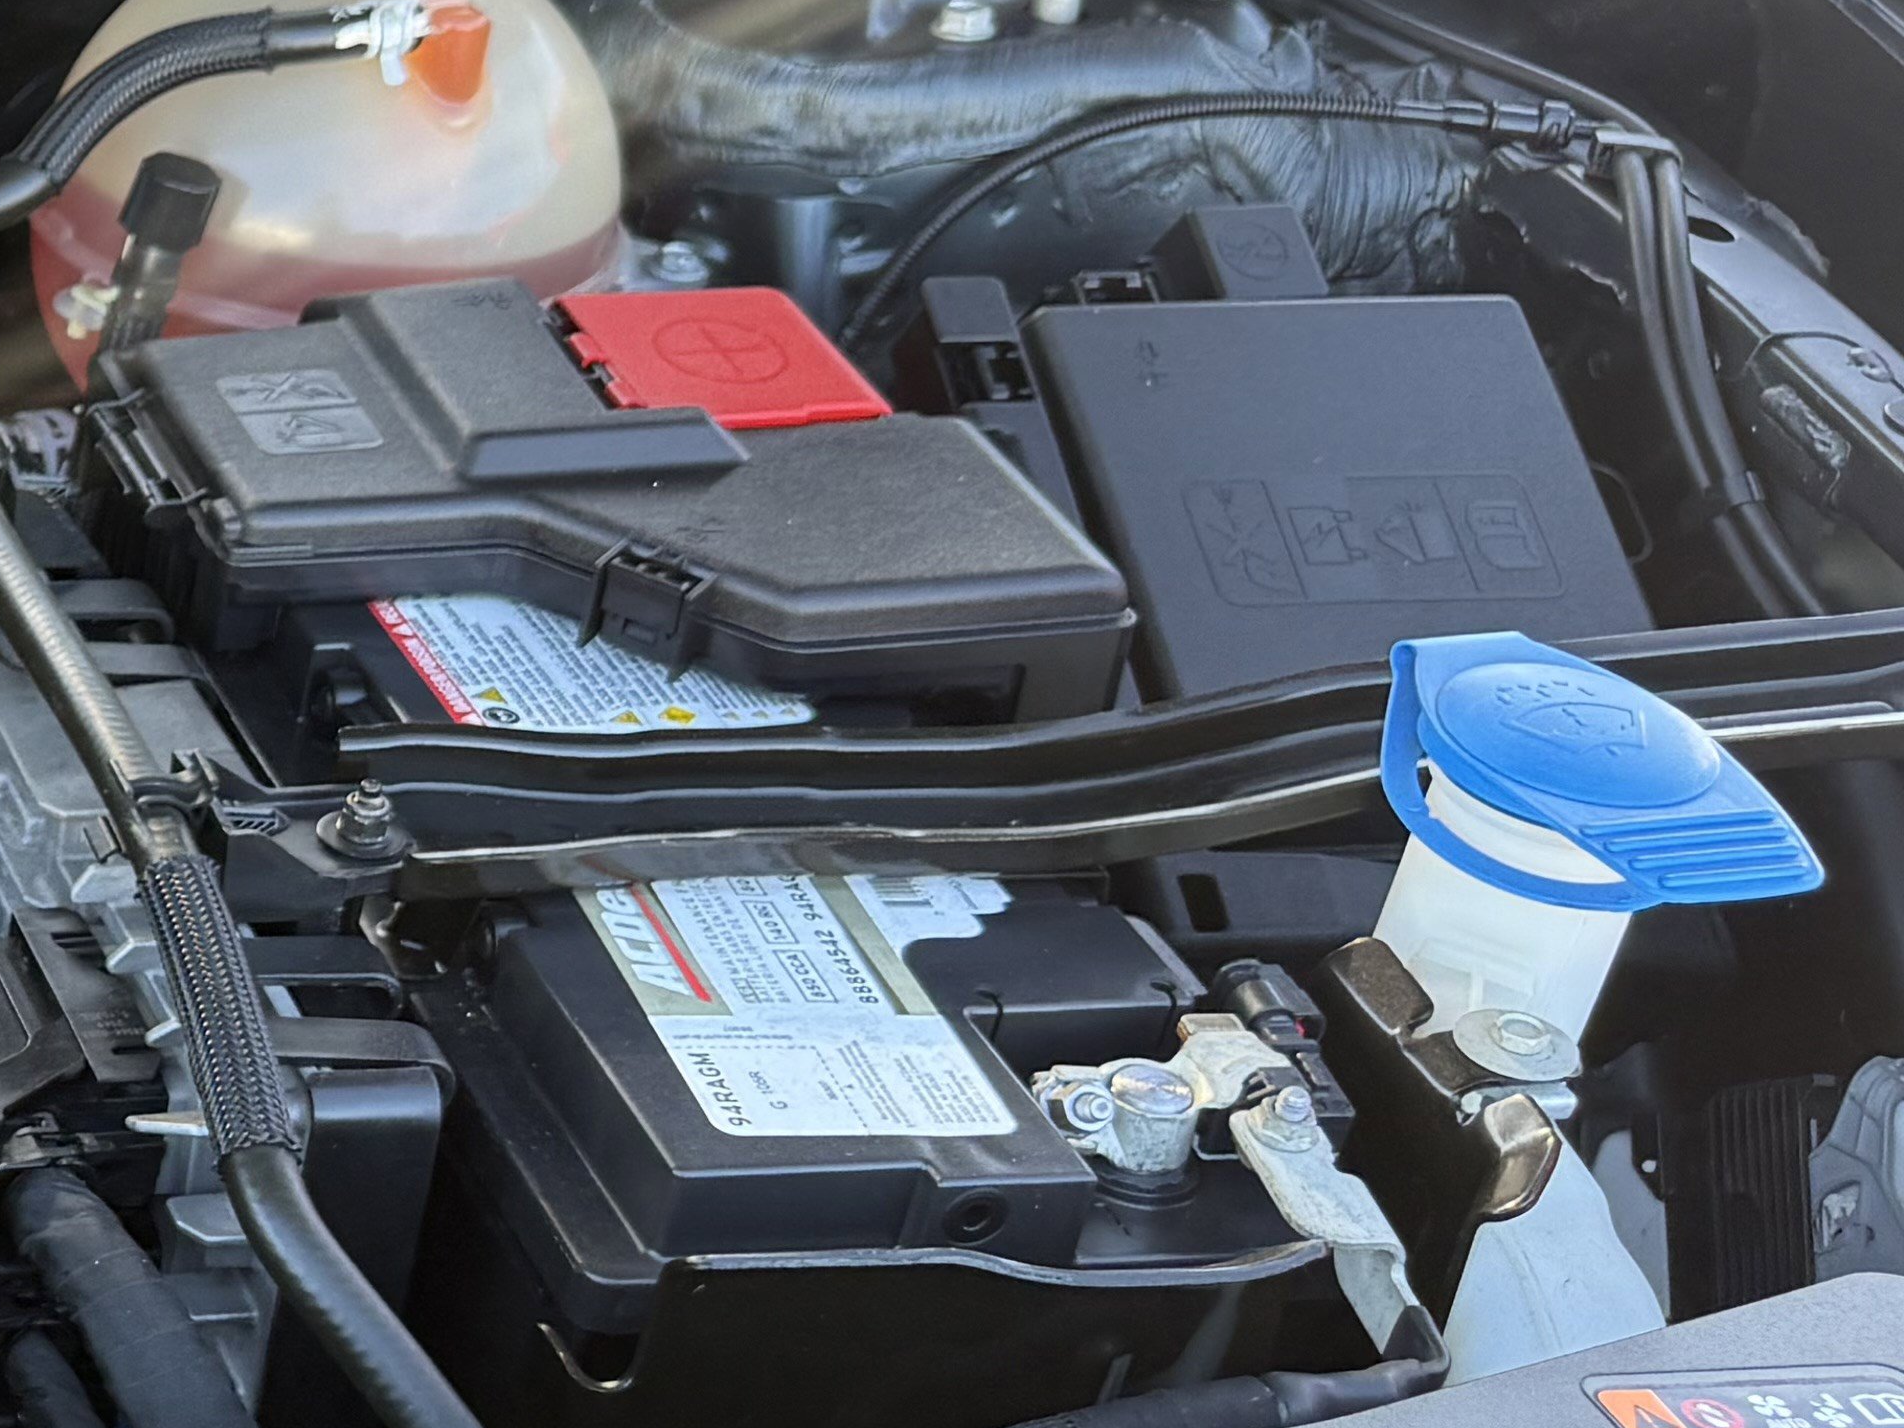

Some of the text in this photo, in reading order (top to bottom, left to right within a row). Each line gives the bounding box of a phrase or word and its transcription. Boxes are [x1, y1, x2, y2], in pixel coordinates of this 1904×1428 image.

[786, 953, 810, 975] CCA
[814, 928, 879, 1004] 88864542
[687, 1052, 752, 1127] 94RAGM
